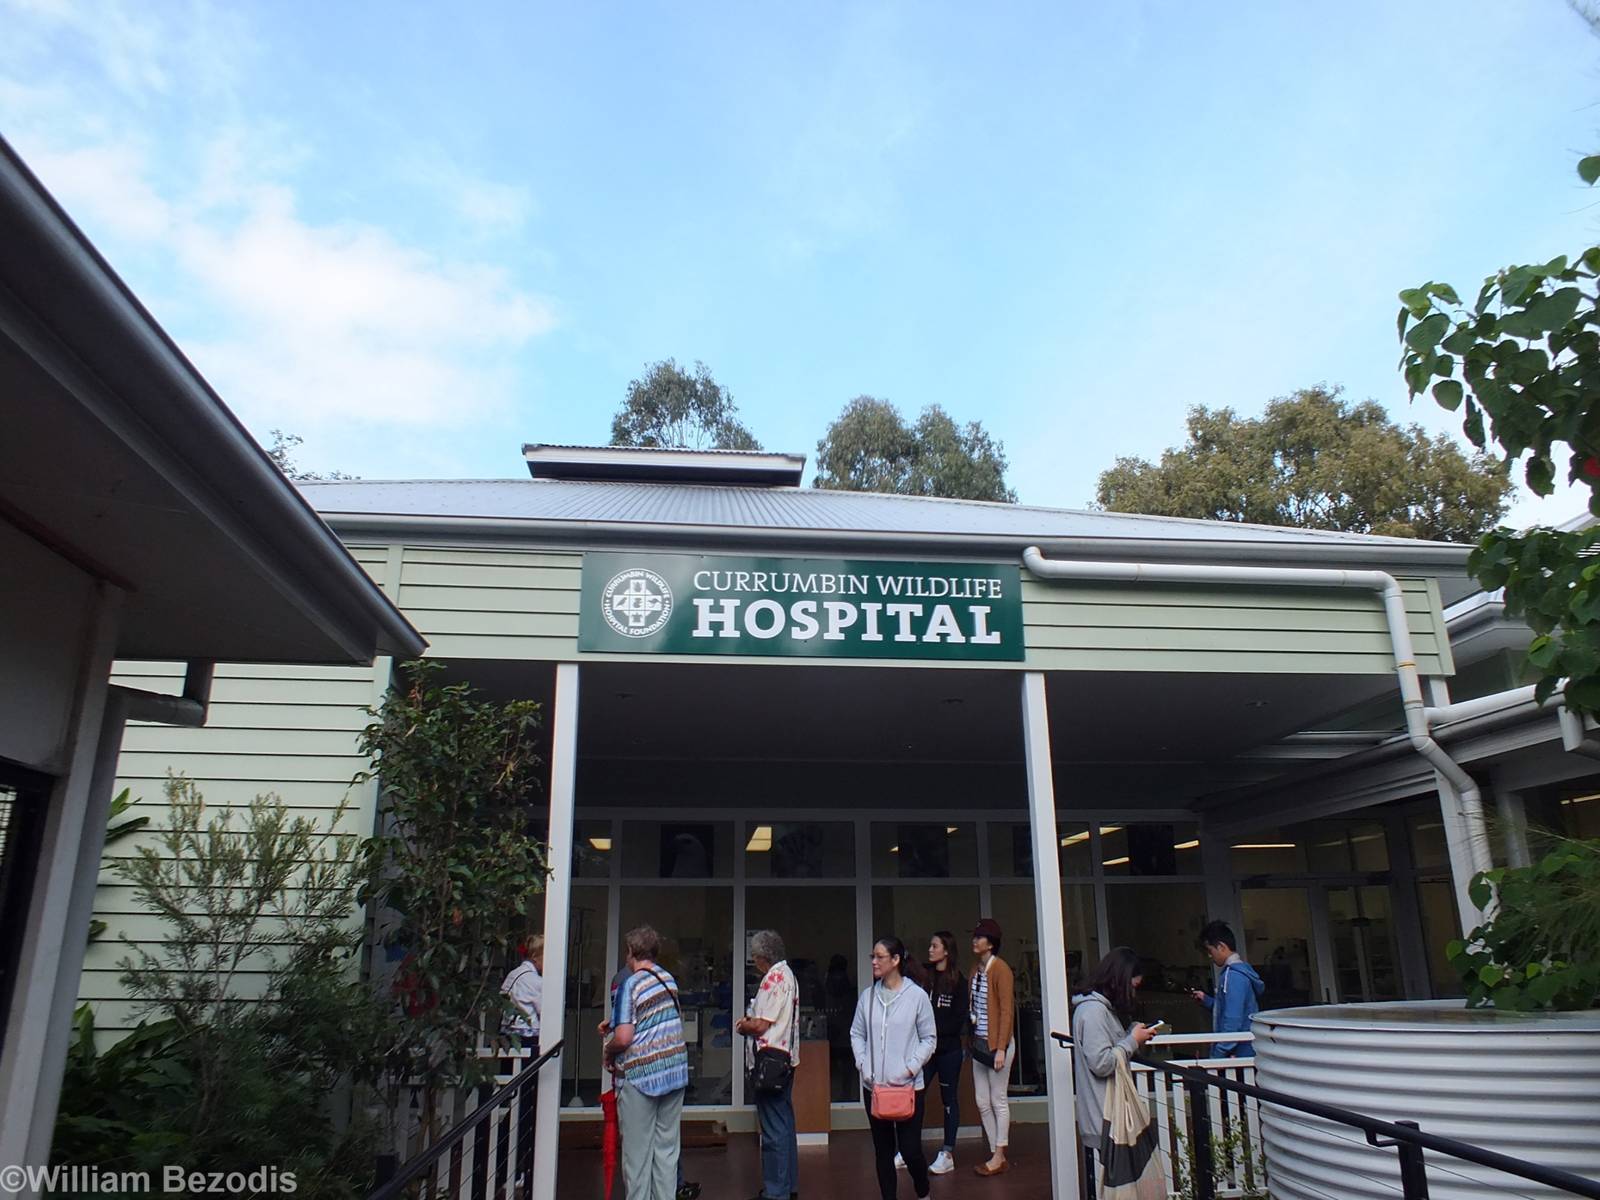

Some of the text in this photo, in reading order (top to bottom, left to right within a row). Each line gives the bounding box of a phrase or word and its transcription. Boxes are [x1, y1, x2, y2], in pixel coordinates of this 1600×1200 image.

[606, 571, 670, 599] CURRUMBIN WILDLIFE
[693, 571, 1002, 599] CURRUMBIN WILDLIFE
[604, 603, 671, 635] HOSPITAL FOUNDATION
[692, 598, 1002, 644] HOSPITAL
